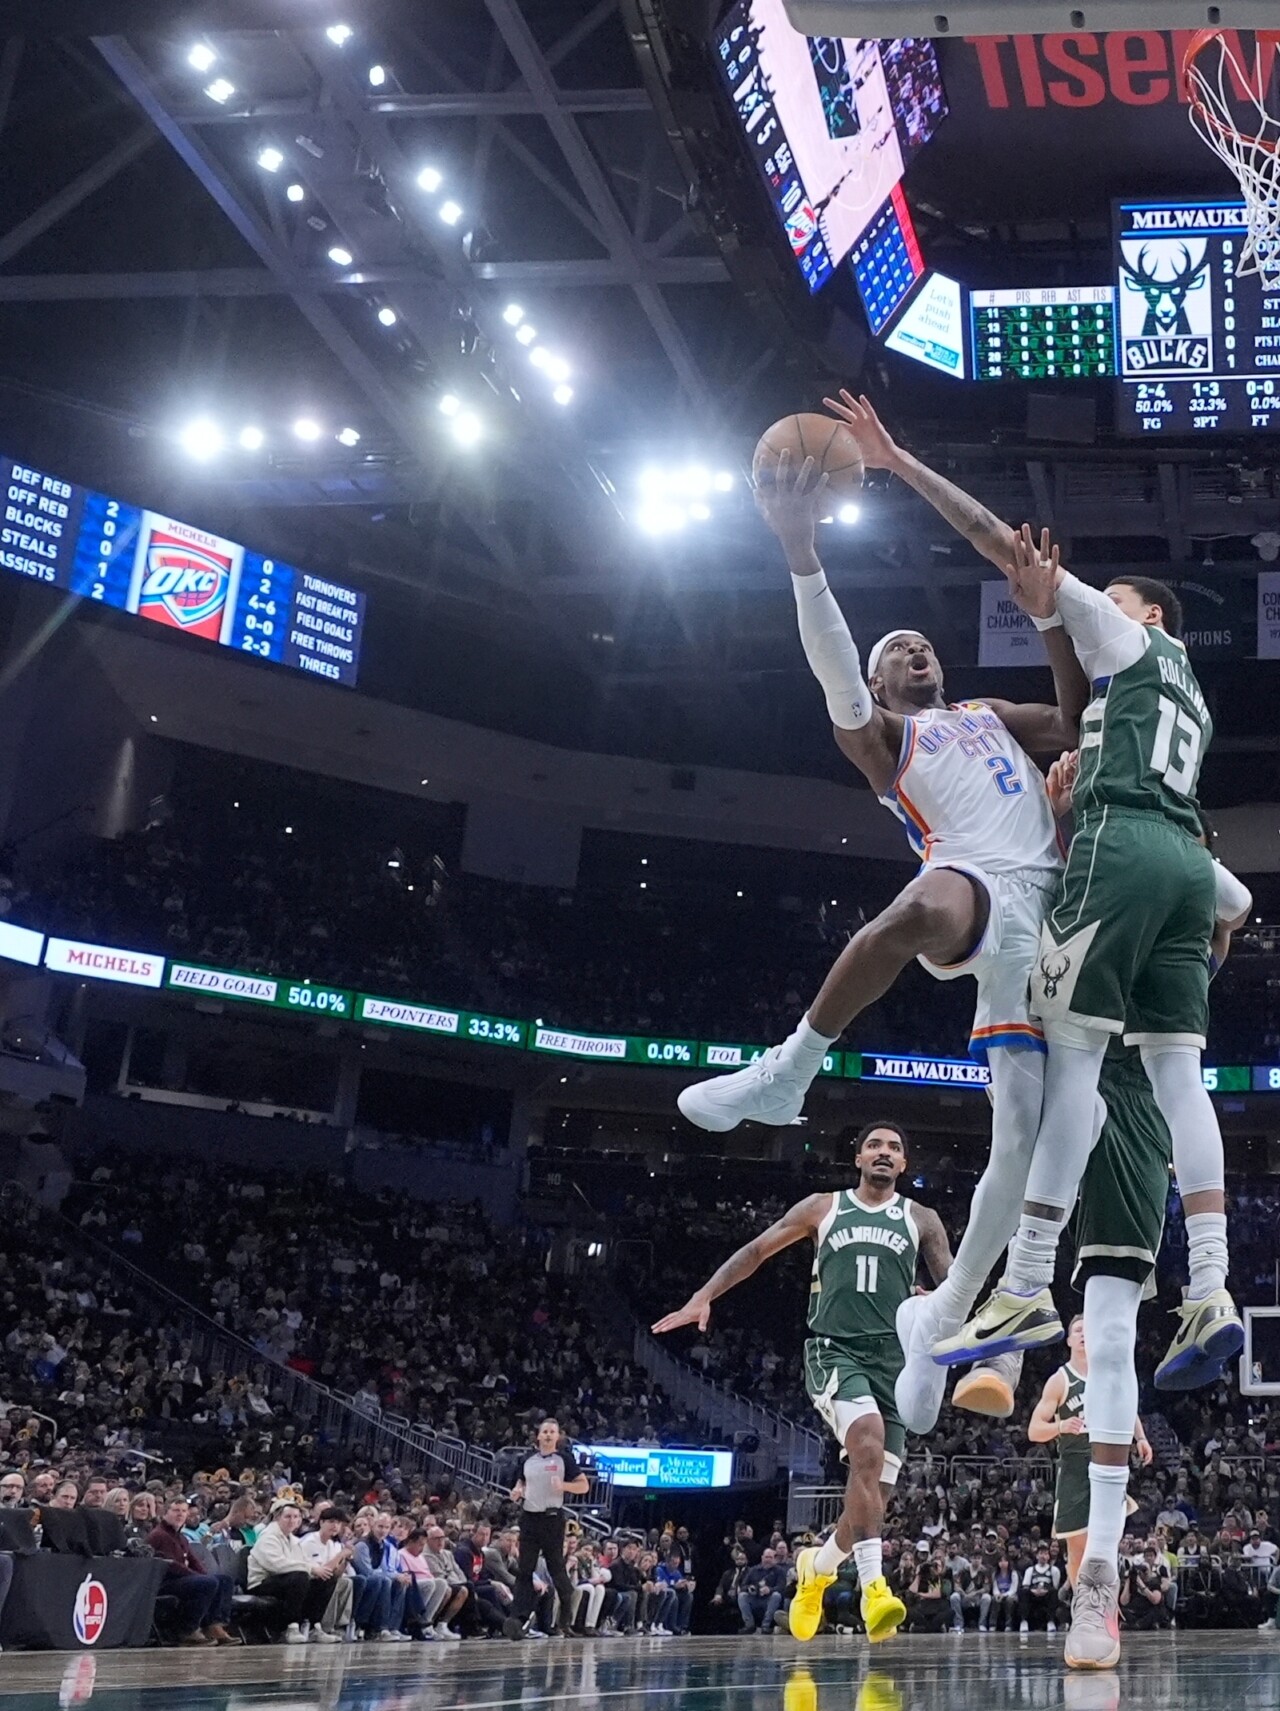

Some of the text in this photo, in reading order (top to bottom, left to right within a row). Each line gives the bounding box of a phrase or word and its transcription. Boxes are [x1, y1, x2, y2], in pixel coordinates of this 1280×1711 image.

[757, 118, 777, 145] 5
[1222, 240, 1233, 254] 0
[1223, 259, 1233, 273] 2
[1225, 279, 1233, 293] 1
[1224, 298, 1234, 312] 0
[1224, 316, 1235, 330] 0
[1127, 339, 1207, 370] BUCKS
[1225, 335, 1236, 349] 0
[1254, 335, 1273, 347] PTS
[1227, 354, 1235, 368] 1
[1138, 383, 1166, 399] 2-4
[1192, 382, 1220, 396] 1-3
[1246, 380, 1274, 395] 0-0
[1135, 400, 1173, 413] 50.0%
[1189, 398, 1227, 411] 33.3%
[1250, 397, 1280, 409] 0.0%
[1143, 418, 1162, 429] FG
[1193, 416, 1218, 428] 3PT
[1251, 414, 1269, 426] FT
[11, 465, 120, 518] DEF REB 2
[8, 485, 116, 536] OFF REB 0
[5, 506, 112, 556] BLOCKS 0
[168, 523, 217, 548] MICHELS
[1, 528, 108, 578] STEALS 1
[91, 583, 105, 600] 2
[142, 565, 217, 596] OKC
[262, 560, 357, 606] 0 TURNOVERS
[259, 579, 358, 625] 2 FAST BREAK PTS
[248, 595, 353, 643] 4-6 FIELD GOALS
[245, 615, 353, 664] 0-0 FREE THROWS
[242, 635, 340, 680] 2-3 THREES
[1150, 694, 1202, 796] 13
[985, 756, 1025, 797] 2
[66, 949, 152, 977] MICHELS
[175, 969, 346, 1012] FIELD GOALS 50.0%
[366, 1002, 520, 1043] 3-POINTERS 33.3%
[539, 1031, 691, 1061] FREE THROWS 0.0%
[710, 1049, 738, 1063] TOL
[875, 1058, 990, 1084] MILWAUKEE
[828, 1226, 909, 1256] MILWAUKEE
[856, 1255, 879, 1293] 11
